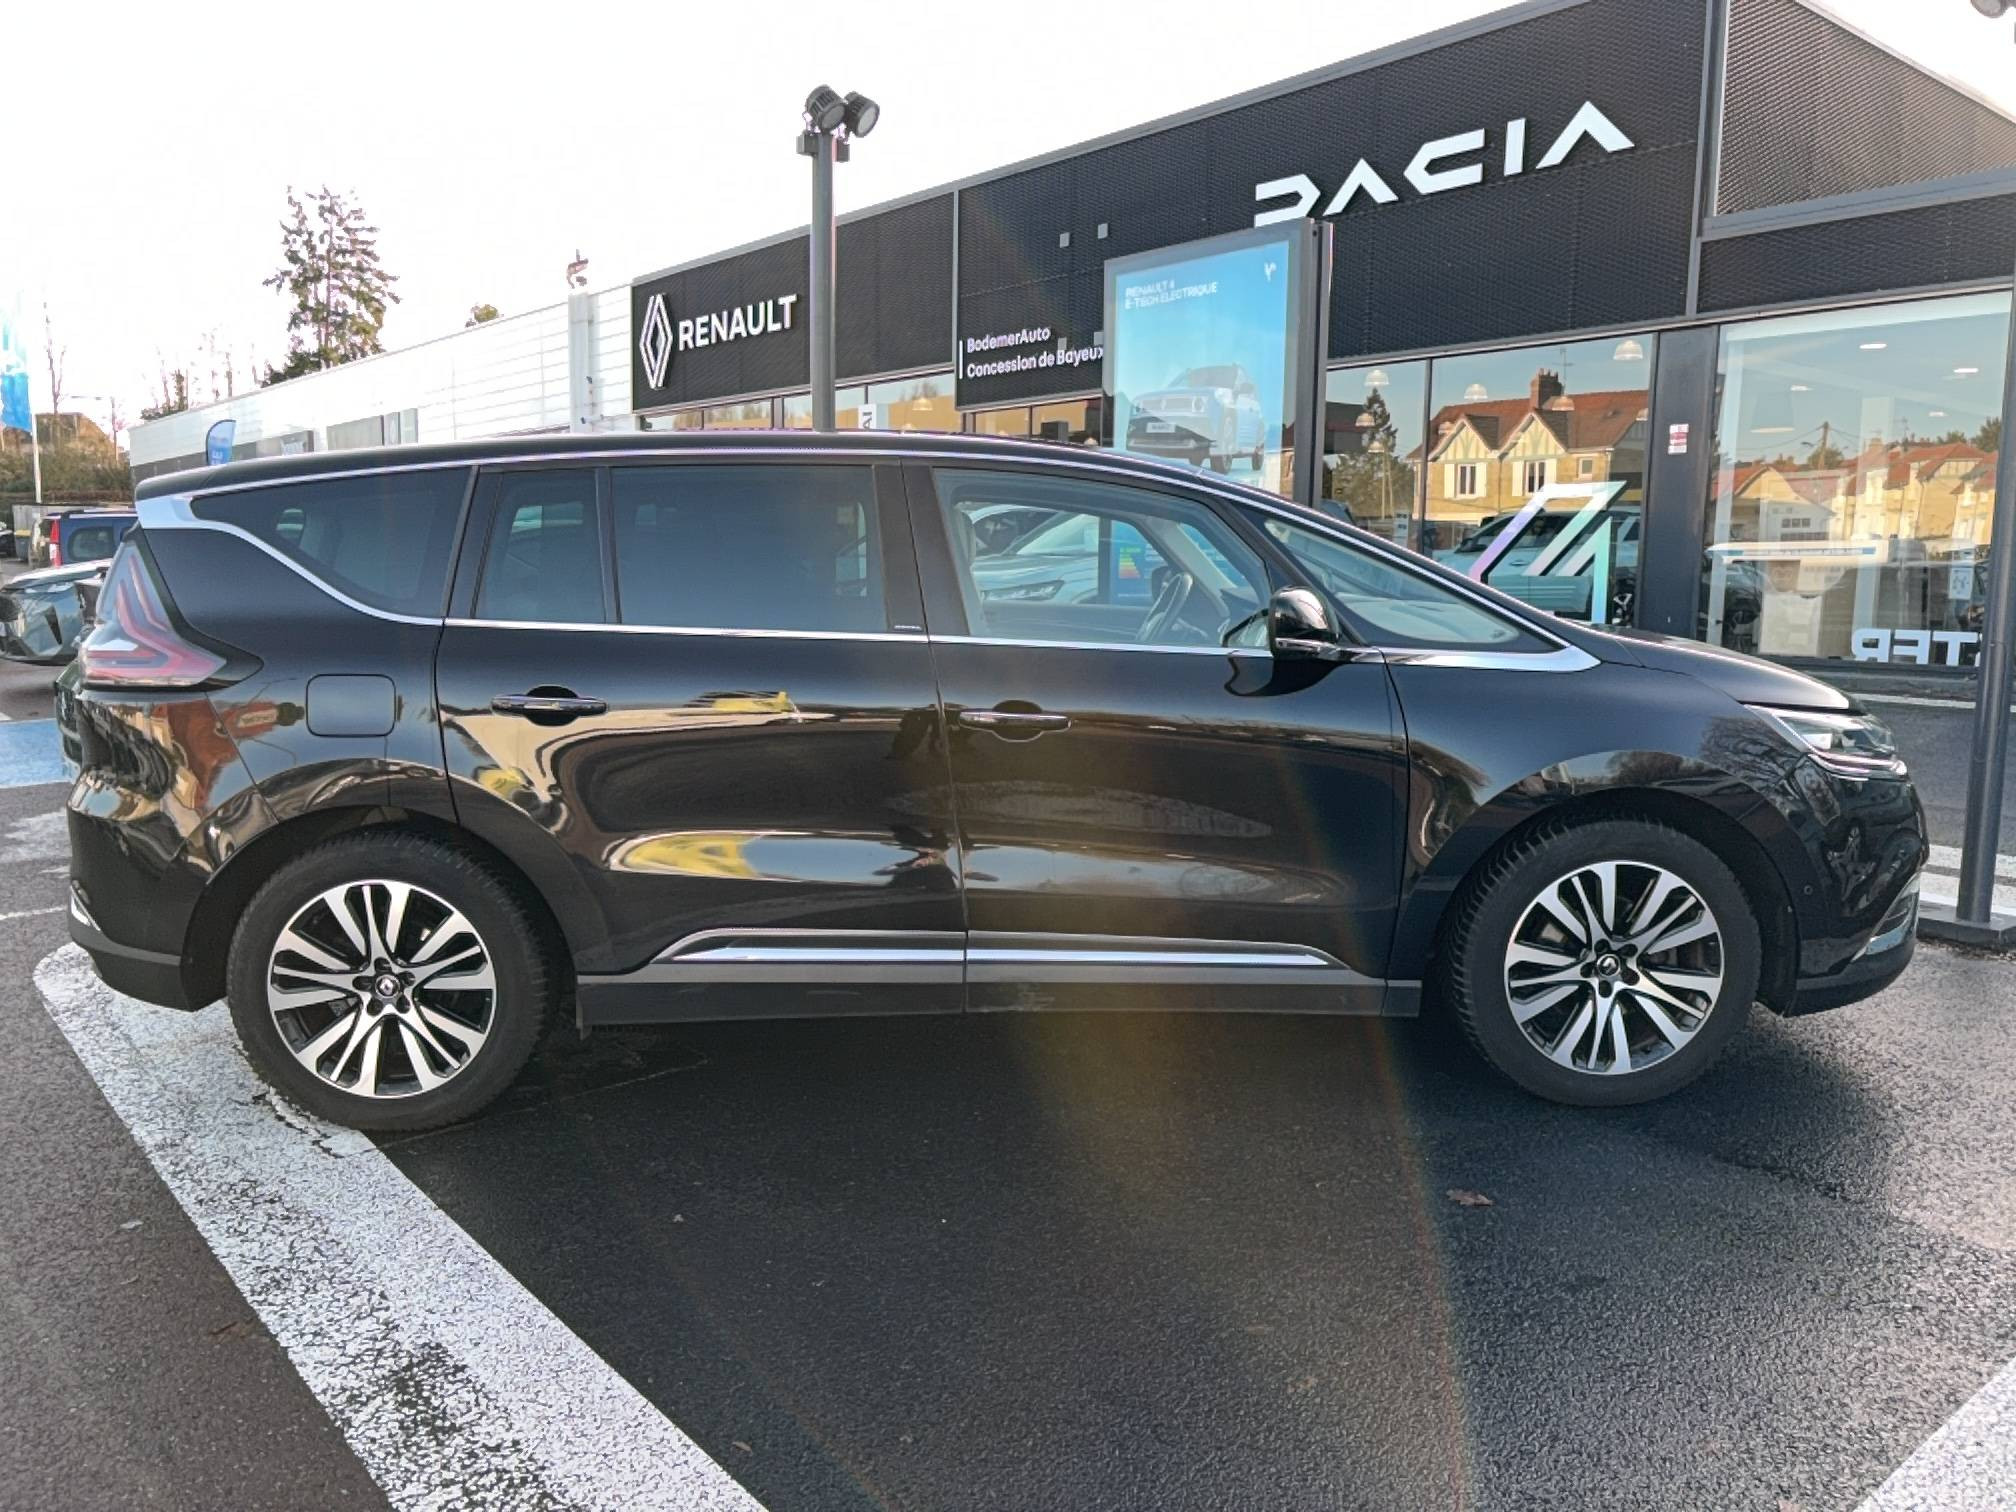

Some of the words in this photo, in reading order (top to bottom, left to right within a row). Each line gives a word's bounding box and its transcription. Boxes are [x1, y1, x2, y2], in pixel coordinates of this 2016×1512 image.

[1254, 100, 1636, 228] DACIA
[678, 293, 798, 351] RENAULT
[967, 327, 1051, 353] BodemerAuto
[967, 355, 1037, 378] Concession
[1038, 351, 1055, 367] de
